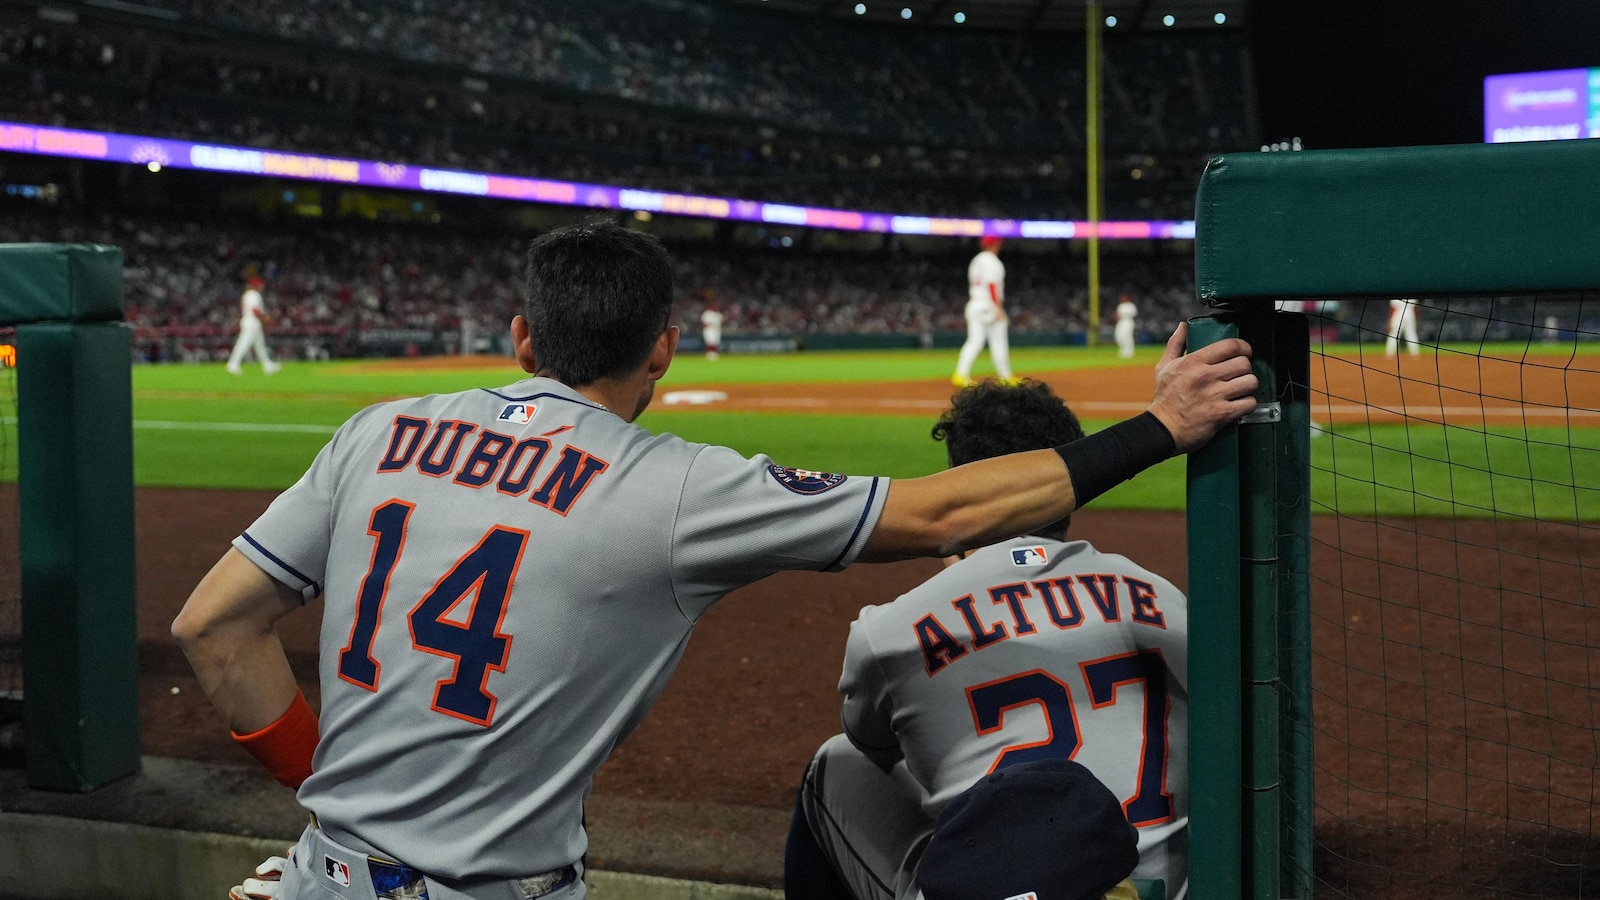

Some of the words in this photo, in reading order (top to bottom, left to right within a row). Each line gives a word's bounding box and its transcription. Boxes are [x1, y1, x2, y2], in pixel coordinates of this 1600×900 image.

[377, 414, 610, 518] DUBÓN
[337, 497, 531, 728] 14
[912, 573, 1168, 678] ALTUVE
[964, 647, 1175, 828] 27
